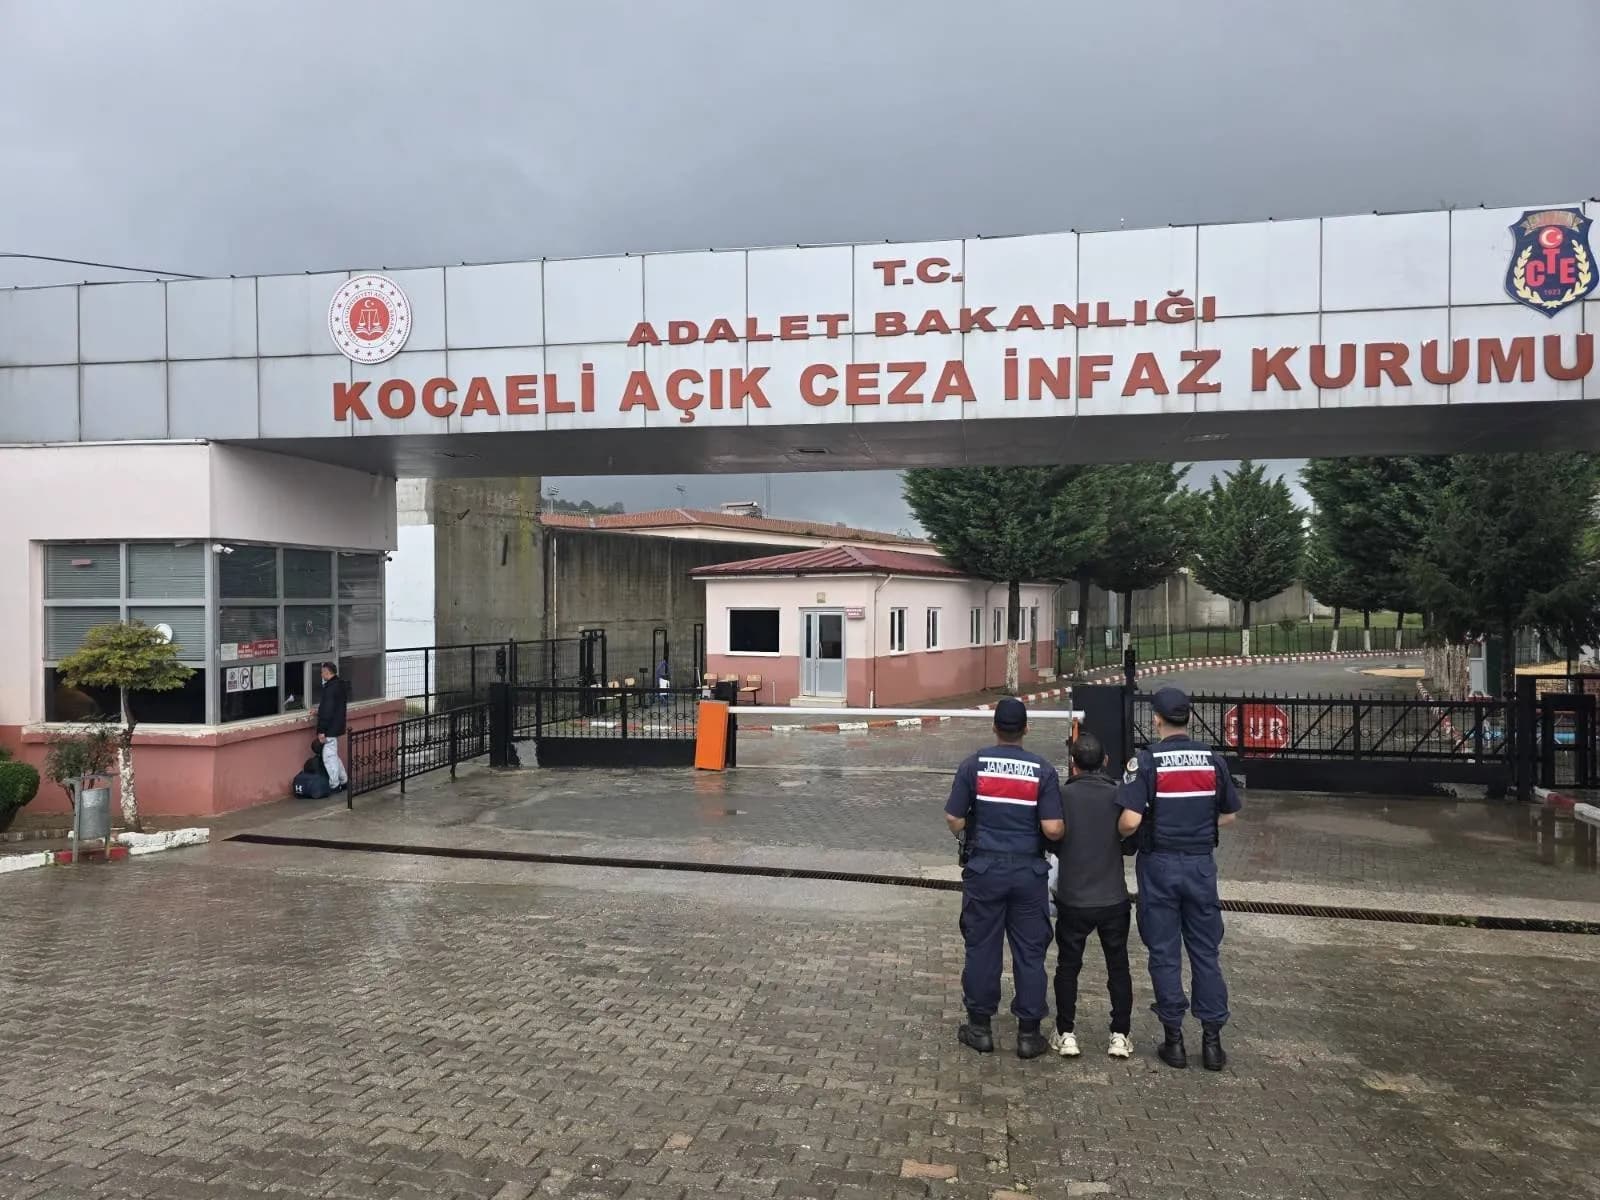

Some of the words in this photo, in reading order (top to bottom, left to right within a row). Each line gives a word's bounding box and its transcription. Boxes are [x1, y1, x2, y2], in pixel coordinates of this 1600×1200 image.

[873, 257, 964, 286] T.C.
[629, 312, 850, 346] ADALET
[875, 288, 1216, 337] BAKANLIĞI
[333, 362, 595, 421] KOCAELİ
[619, 366, 772, 423] AÇIK
[799, 360, 977, 406] CEZA
[1004, 347, 1221, 401] İNFAZ
[1251, 333, 1594, 392] KURUMU
[983, 760, 1035, 777] JANDARMA
[1160, 753, 1210, 767] JANDARMA
